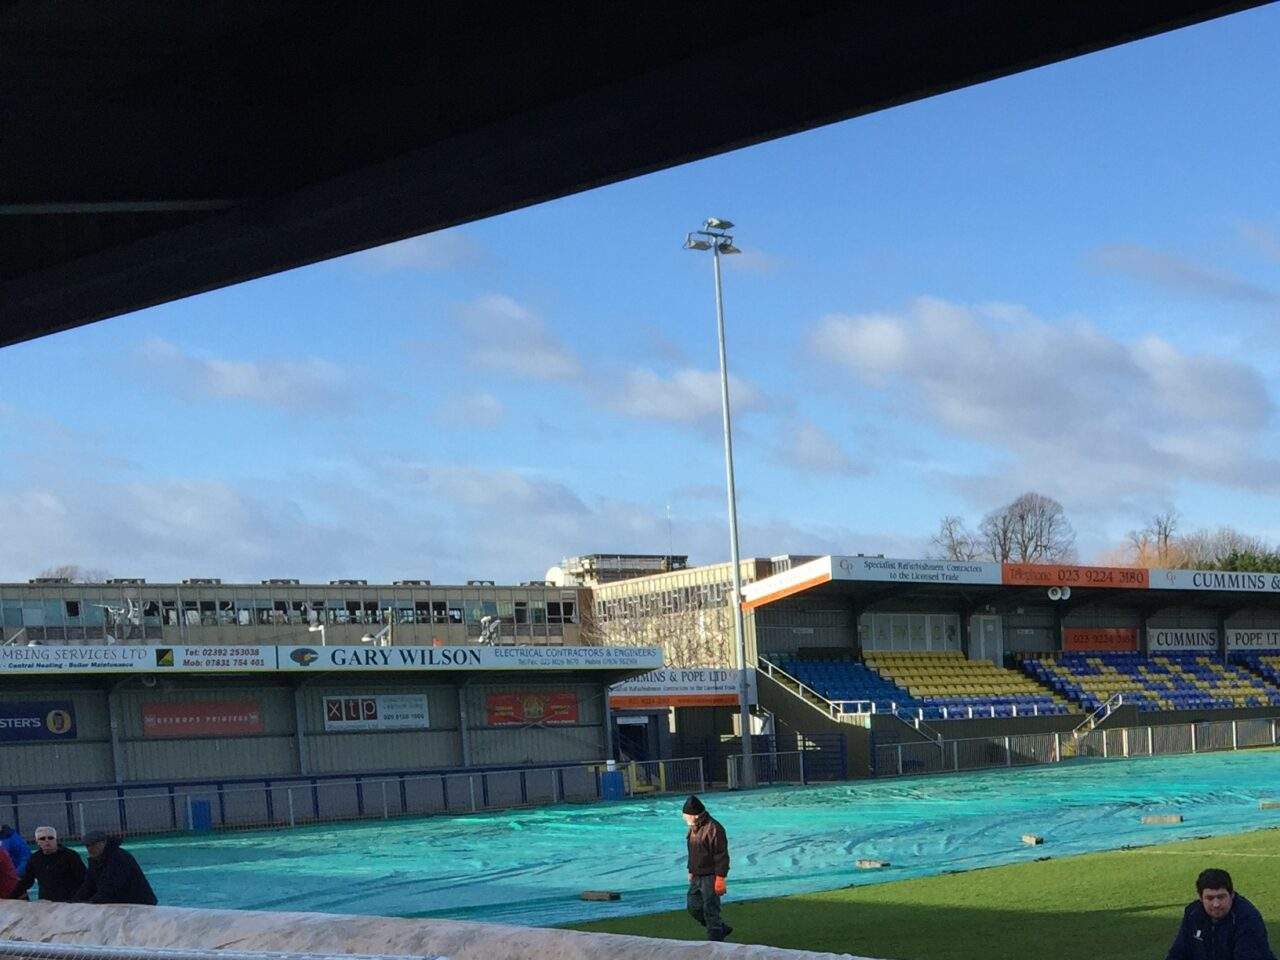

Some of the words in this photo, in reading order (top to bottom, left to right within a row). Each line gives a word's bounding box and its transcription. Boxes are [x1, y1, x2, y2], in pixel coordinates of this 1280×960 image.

[1057, 569, 1081, 582] 023
[1085, 570, 1113, 583] 9224
[1119, 571, 1144, 584] 3180
[1192, 572, 1266, 590] CUMMINS
[1156, 631, 1217, 647] CUMMINS
[1235, 632, 1263, 646] POPE
[54, 648, 119, 661] SERVICES
[122, 648, 148, 660] LTD
[330, 649, 392, 666] GARY
[399, 649, 481, 666] WILSON
[494, 648, 543, 657] ELECTRICAL
[545, 648, 604, 658] CONTRACTORS
[614, 648, 657, 657] ENGINEERS
[182, 659, 203, 667] Mob:
[669, 671, 679, 682] &
[682, 671, 706, 682] POPE
[709, 671, 728, 682] LTD
